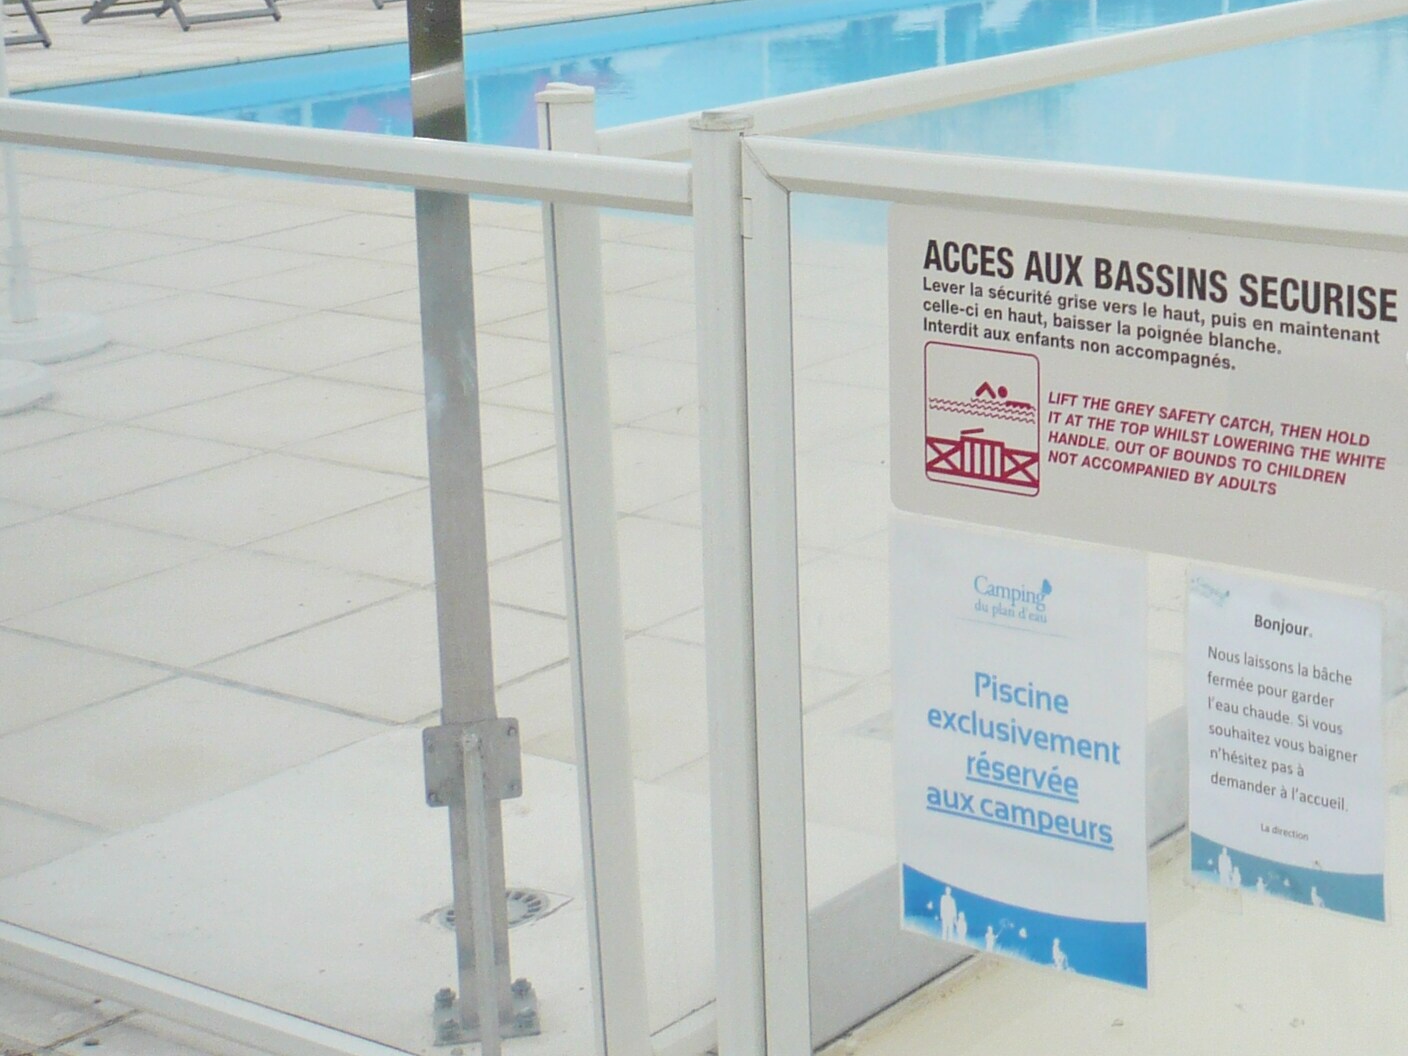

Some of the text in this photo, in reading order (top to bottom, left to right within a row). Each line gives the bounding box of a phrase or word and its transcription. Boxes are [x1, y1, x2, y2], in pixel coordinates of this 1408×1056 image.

[922, 239, 1397, 322] ACCES AUX BASSINS SECURISE
[922, 276, 1380, 344] Lever la sécurité grise vers le haut, puis en maintenant
[922, 300, 1281, 354] celle-ci en haut, baisser la poignée blanche.
[923, 318, 1235, 370] Interdit aux enfants non accompagnés.
[1047, 411, 1386, 470] IT AT THE TOP WHILST LOWERING THE WHITE
[1048, 391, 1369, 446] LIFT THE GREY SAFETY CATCH, THEN HOLD
[1047, 450, 1276, 495] NOT ACCOMPANIED BY ADULTS
[1114, 439, 1145, 455] OUT
[1148, 444, 1169, 458] OF
[1172, 448, 1236, 469] BOUNDS
[1241, 457, 1262, 472] TO
[1266, 461, 1346, 485] CHILDREN
[973, 575, 1047, 611] Camping
[974, 598, 988, 613] du
[1207, 645, 1352, 685] Nous laissons la bâche
[974, 671, 1068, 714] Piscine
[1207, 670, 1334, 707] fermée pour garder
[927, 707, 1120, 765] exclusivement
[1207, 696, 1238, 714] l'eau
[1297, 713, 1308, 728] Si
[1312, 719, 1342, 735] vous
[1208, 724, 1357, 763] souhaitez vous baigner
[1209, 746, 1304, 777] n'hésitez pas à
[966, 752, 1078, 797] réservée
[1210, 772, 1349, 812] demander à l'accueil.
[925, 786, 1113, 845] aux campeurs
[1260, 823, 1308, 840] La direction
